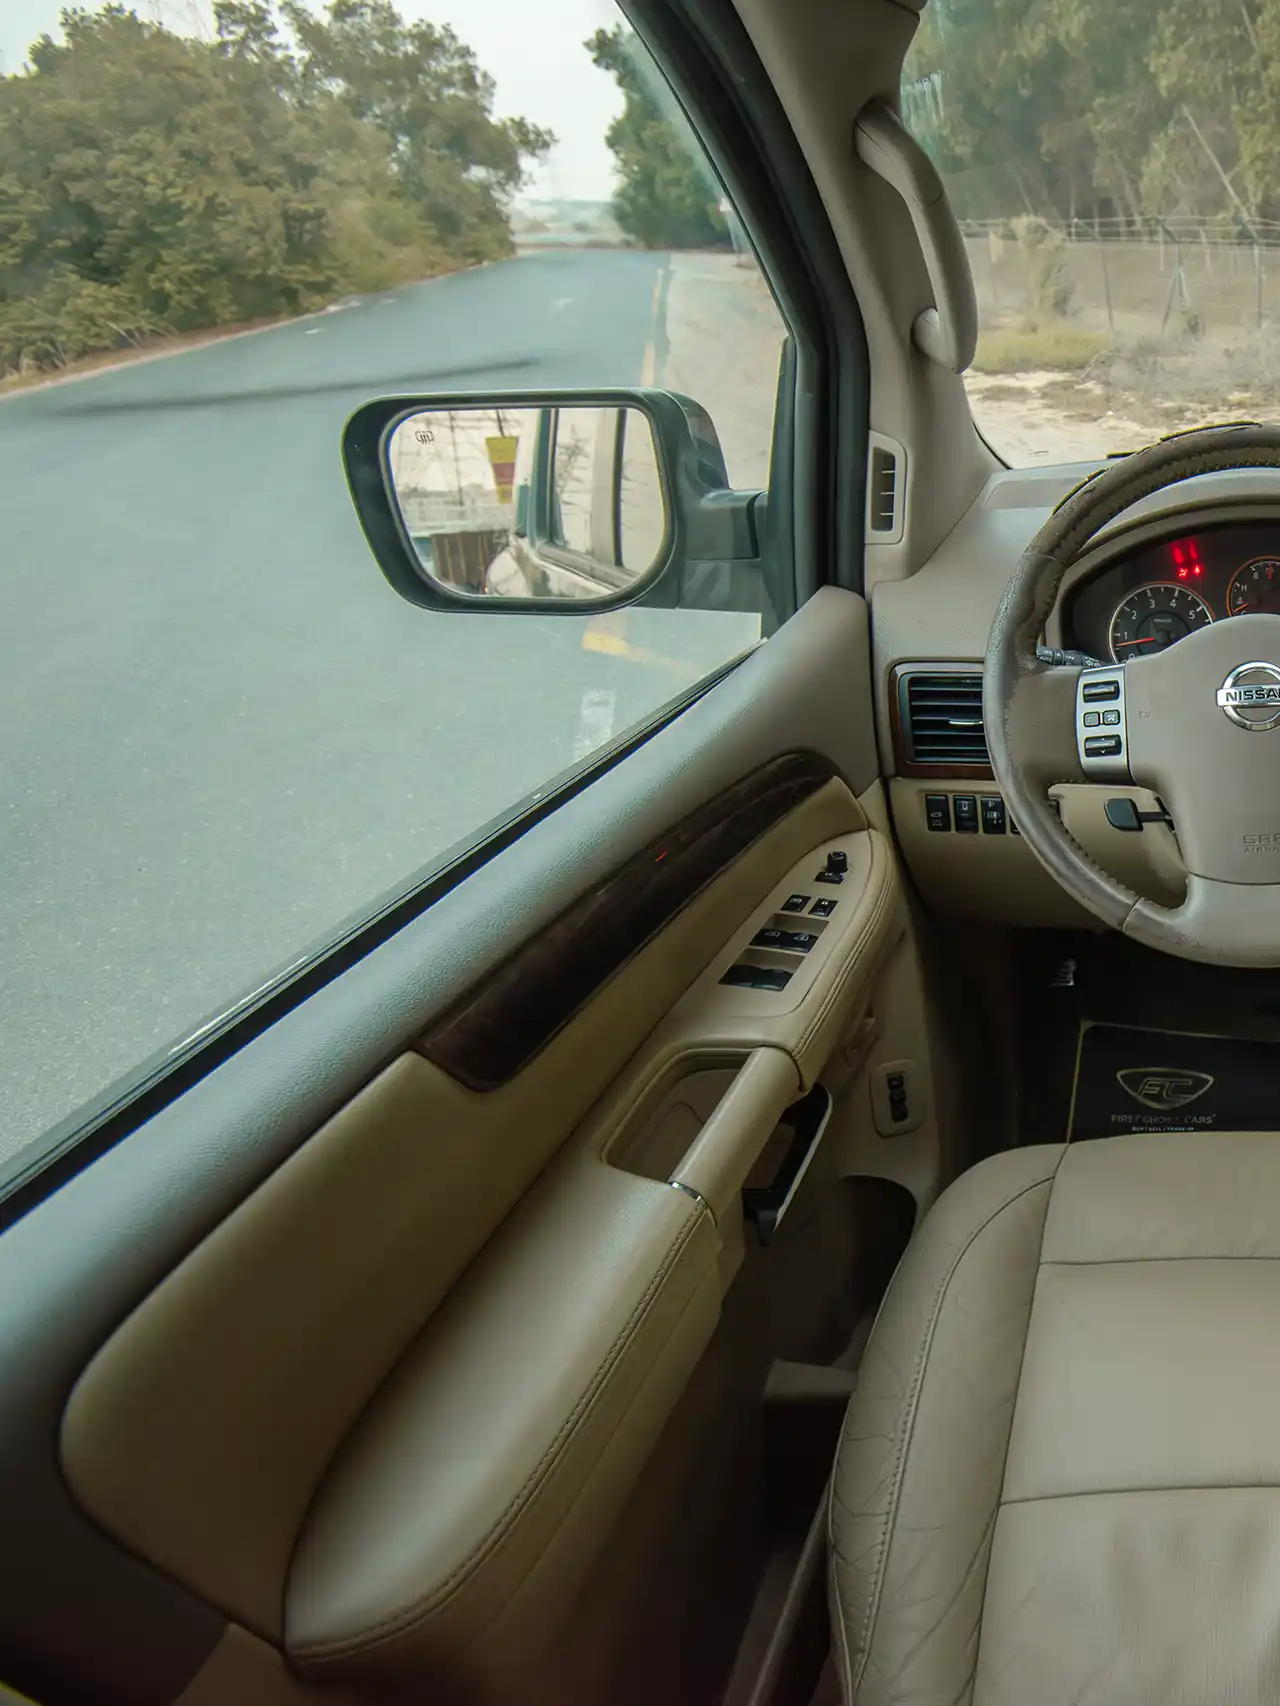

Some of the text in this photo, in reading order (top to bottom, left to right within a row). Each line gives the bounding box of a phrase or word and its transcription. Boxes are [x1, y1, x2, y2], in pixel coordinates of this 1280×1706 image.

[1149, 599, 1156, 609] 3
[1169, 599, 1177, 608] 4
[1131, 610, 1137, 620] 2
[1188, 610, 1196, 620] 5
[1124, 631, 1129, 640] 1
[1110, 1114, 1141, 1123] FIRST
[1184, 1115, 1213, 1124] CARS
